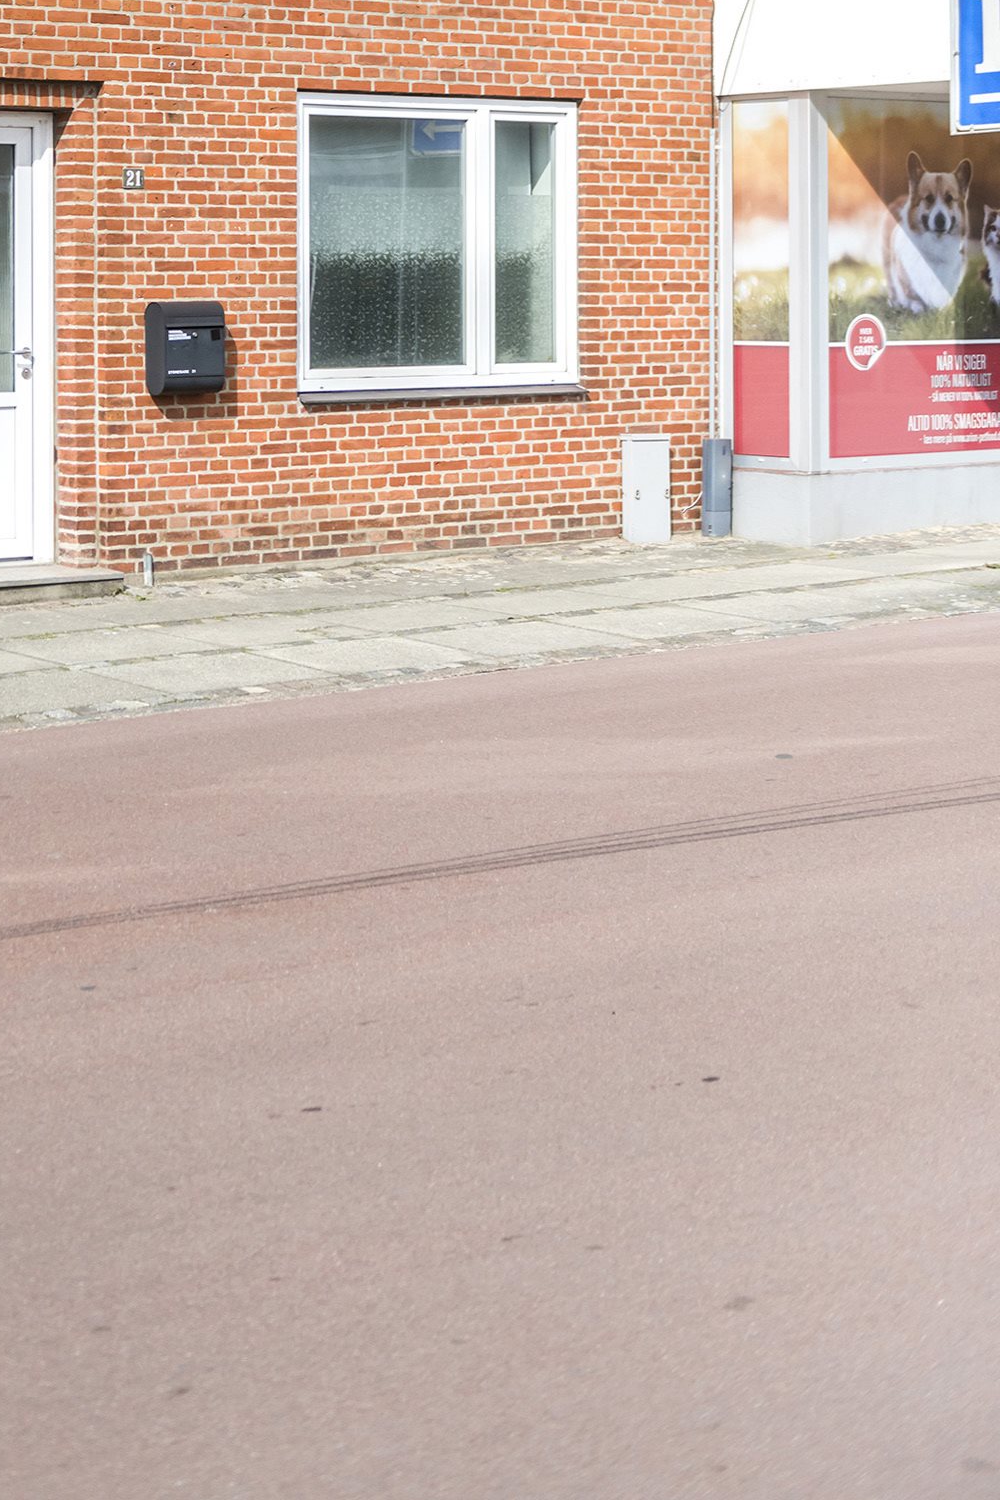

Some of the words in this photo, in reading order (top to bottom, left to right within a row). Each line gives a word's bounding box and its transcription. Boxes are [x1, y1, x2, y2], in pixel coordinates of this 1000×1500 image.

[126, 169, 142, 187] 21
[936, 350, 953, 371] NÅR
[954, 355, 962, 370] VI
[963, 354, 987, 371] SIGER
[930, 374, 951, 388] 100%
[952, 373, 992, 388] NATURLIGT
[908, 414, 930, 431] ALTID
[931, 413, 953, 430] 100%
